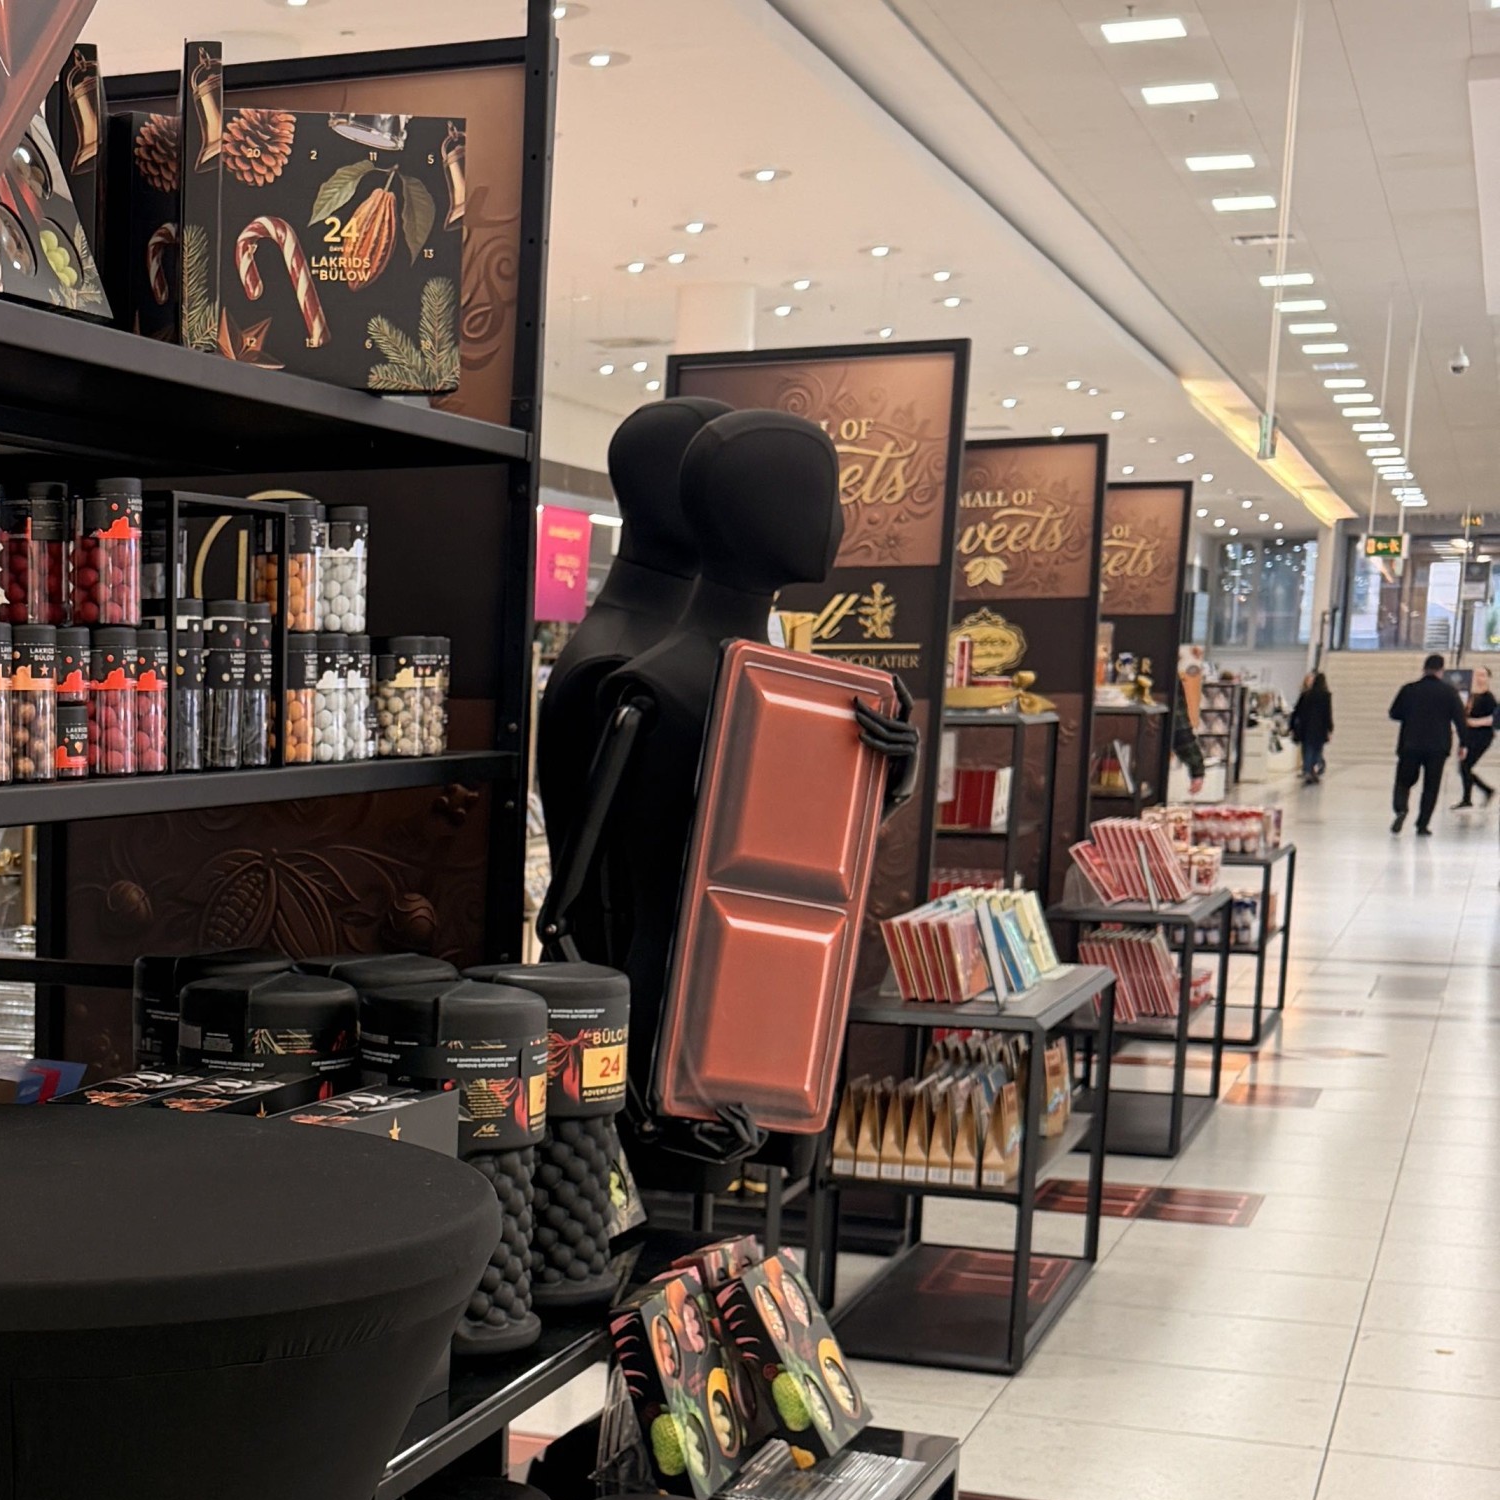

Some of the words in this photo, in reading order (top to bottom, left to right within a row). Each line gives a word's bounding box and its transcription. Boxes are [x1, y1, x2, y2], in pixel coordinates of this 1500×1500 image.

[310, 150, 318, 160] 2
[369, 151, 378, 161] 11
[427, 154, 434, 164] 5
[323, 216, 360, 243] 24
[423, 248, 434, 259] 13
[311, 256, 371, 268] LAKRIDS
[319, 267, 371, 282] BÜLOW
[840, 418, 875, 441] OF
[835, 440, 918, 506] ets
[1012, 488, 1037, 507] OF
[599, 1053, 621, 1079] 24
